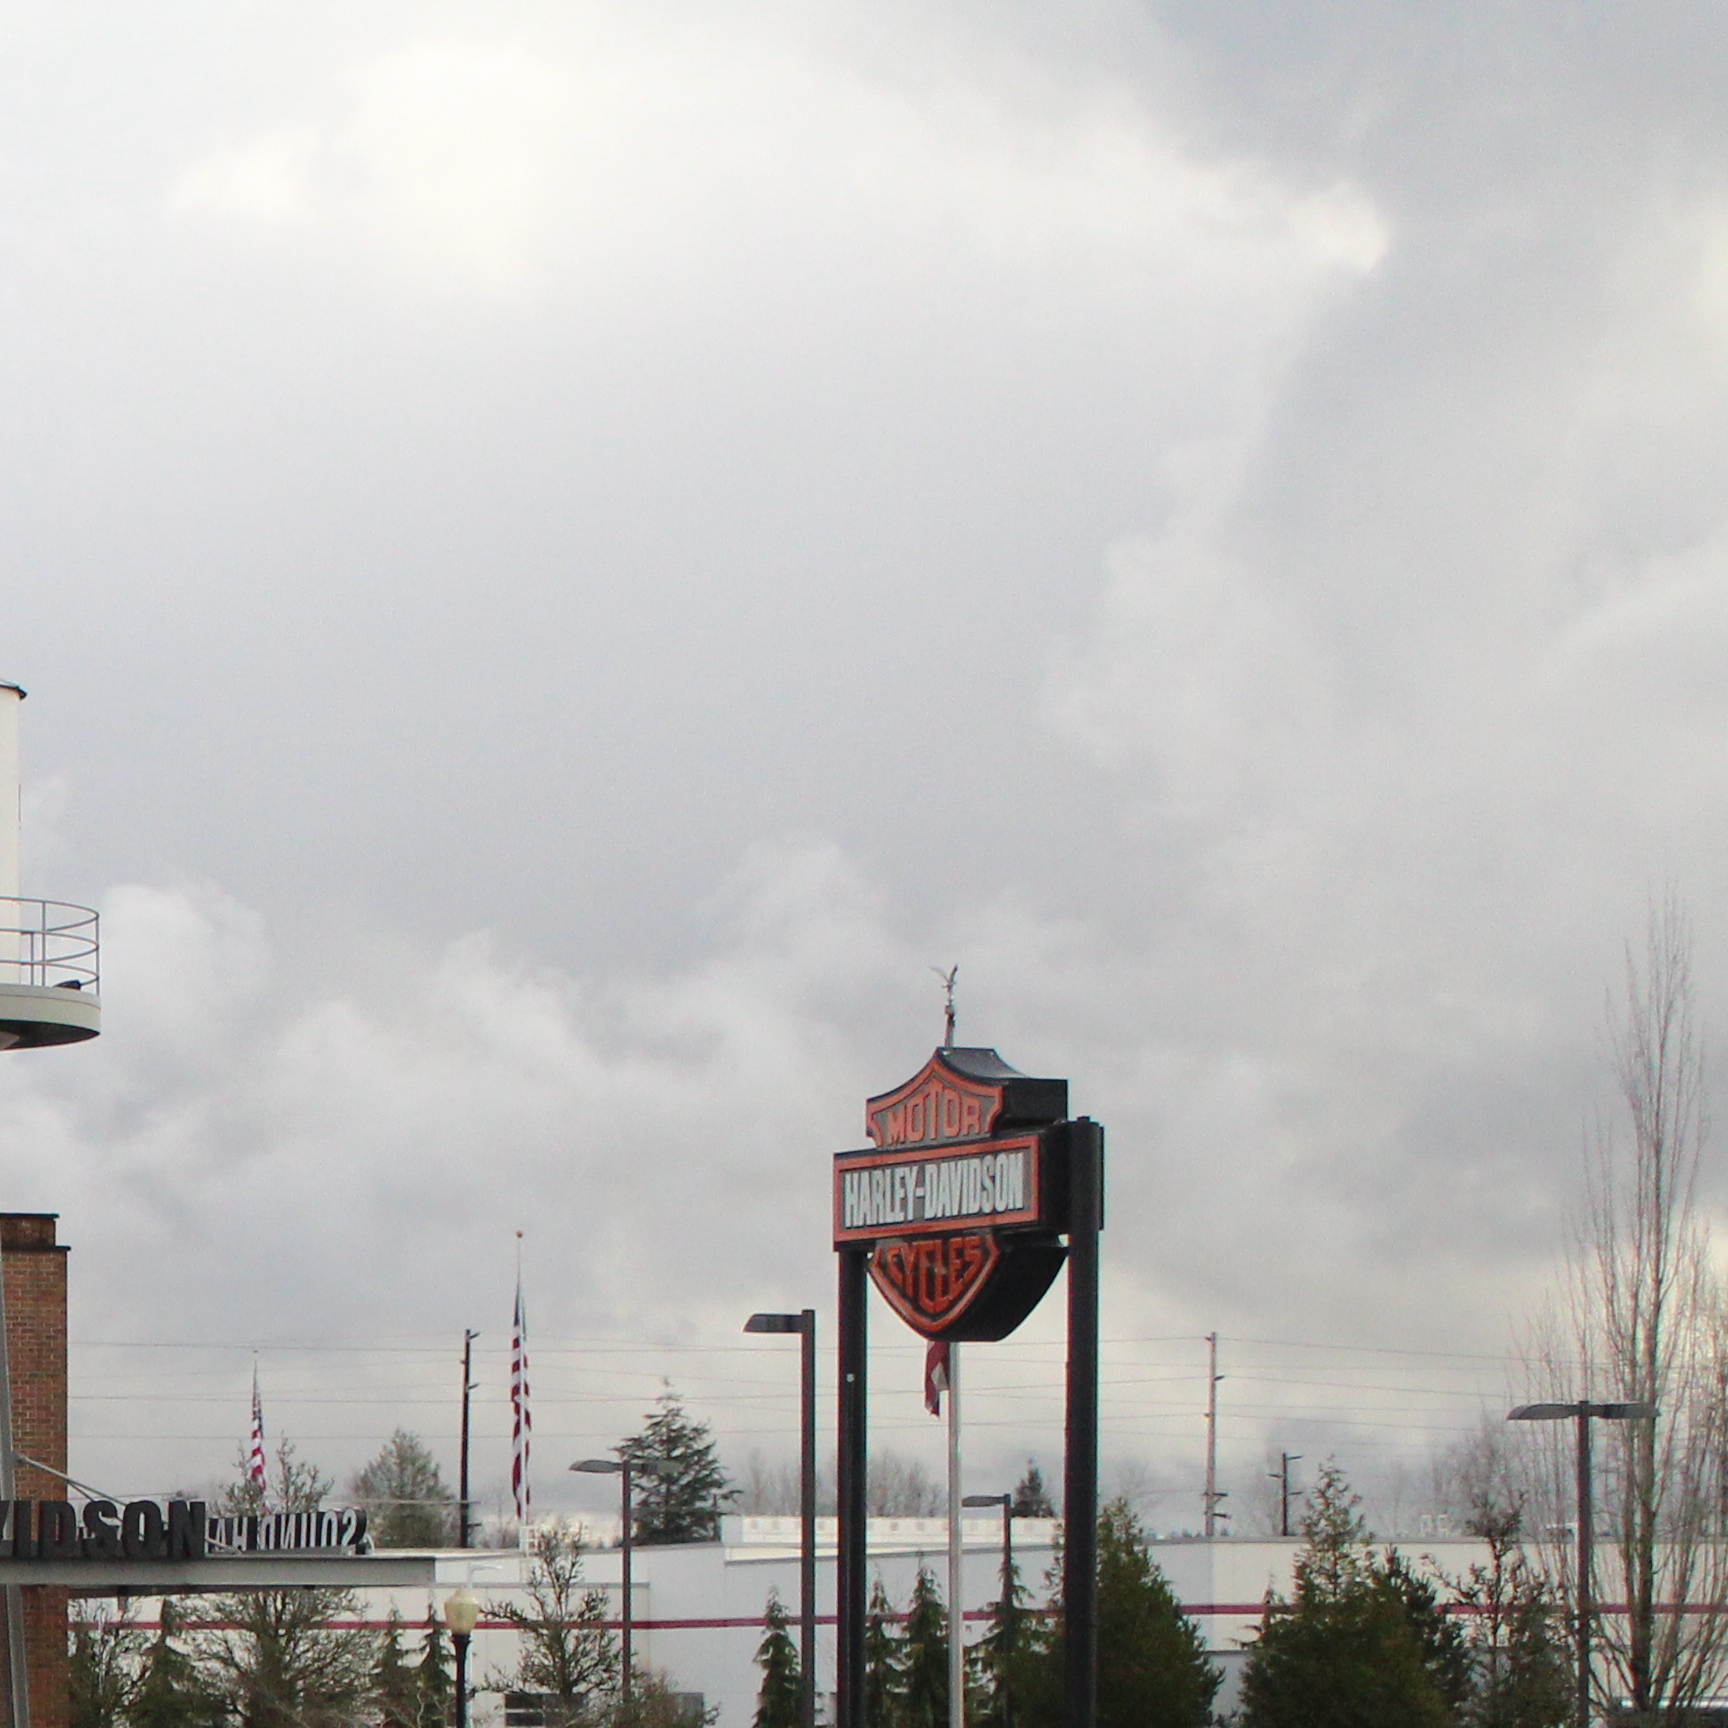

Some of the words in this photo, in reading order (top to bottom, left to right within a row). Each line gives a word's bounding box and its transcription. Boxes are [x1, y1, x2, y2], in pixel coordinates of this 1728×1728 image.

[888, 1079, 982, 1146] MOTOR
[845, 1153, 1024, 1228] HARLEY-DAVIDSON
[887, 1237, 982, 1314] CYCLES
